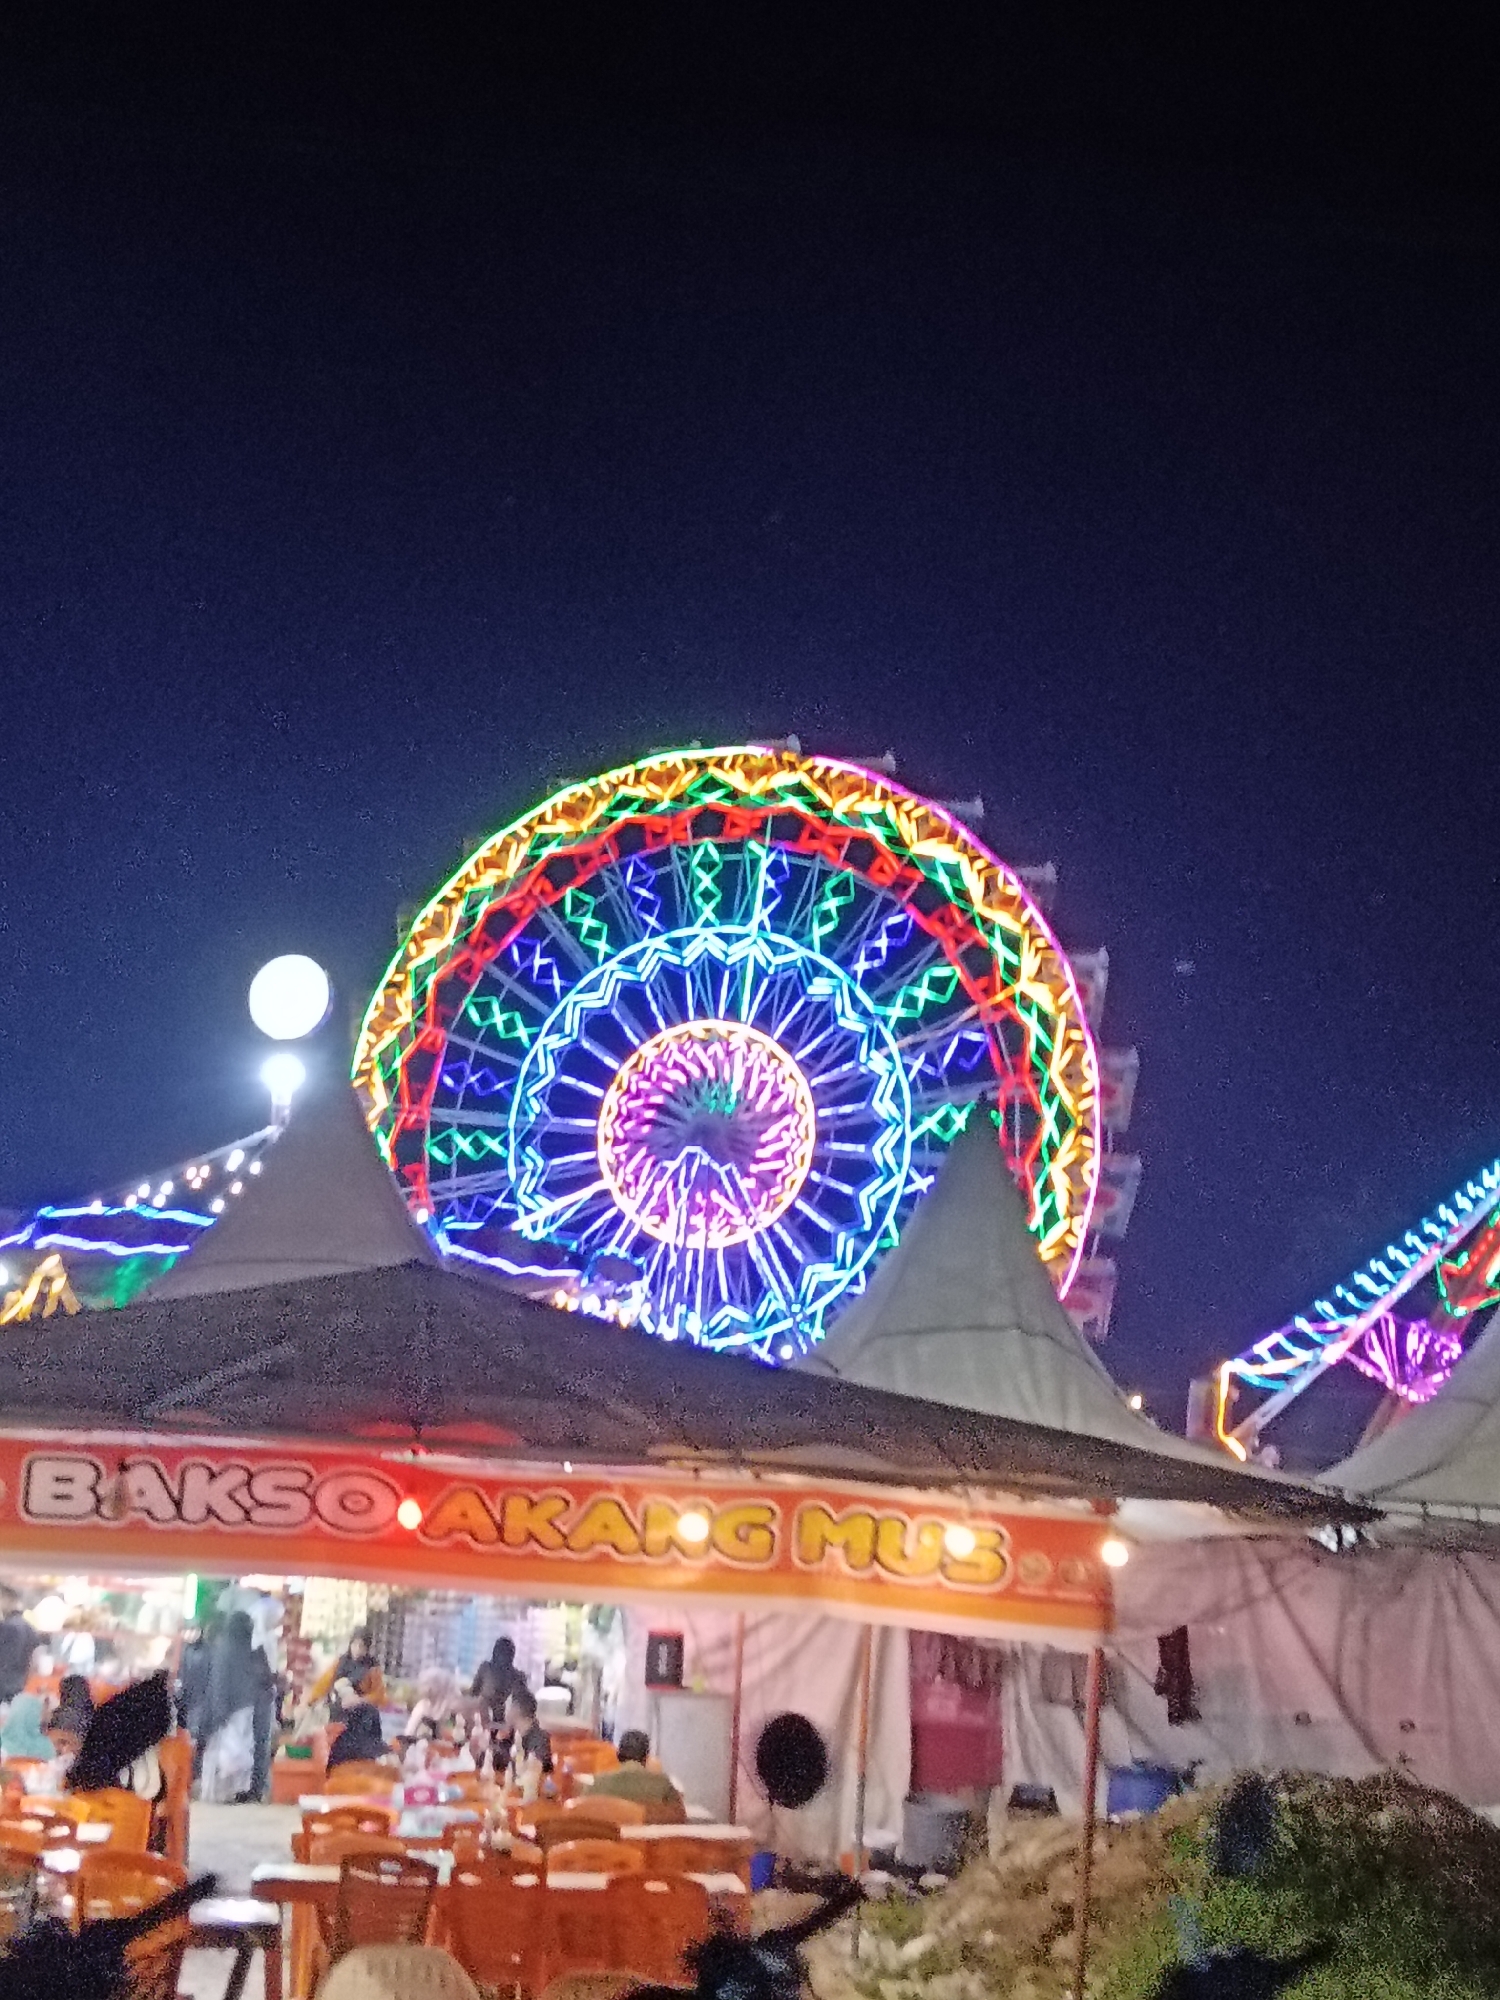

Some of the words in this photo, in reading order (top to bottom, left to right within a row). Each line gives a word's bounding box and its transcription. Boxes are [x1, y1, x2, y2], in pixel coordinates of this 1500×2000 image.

[23, 1454, 401, 1535] BAKSO
[421, 1486, 777, 1566] AKANG
[796, 1503, 1009, 1586] MUS
